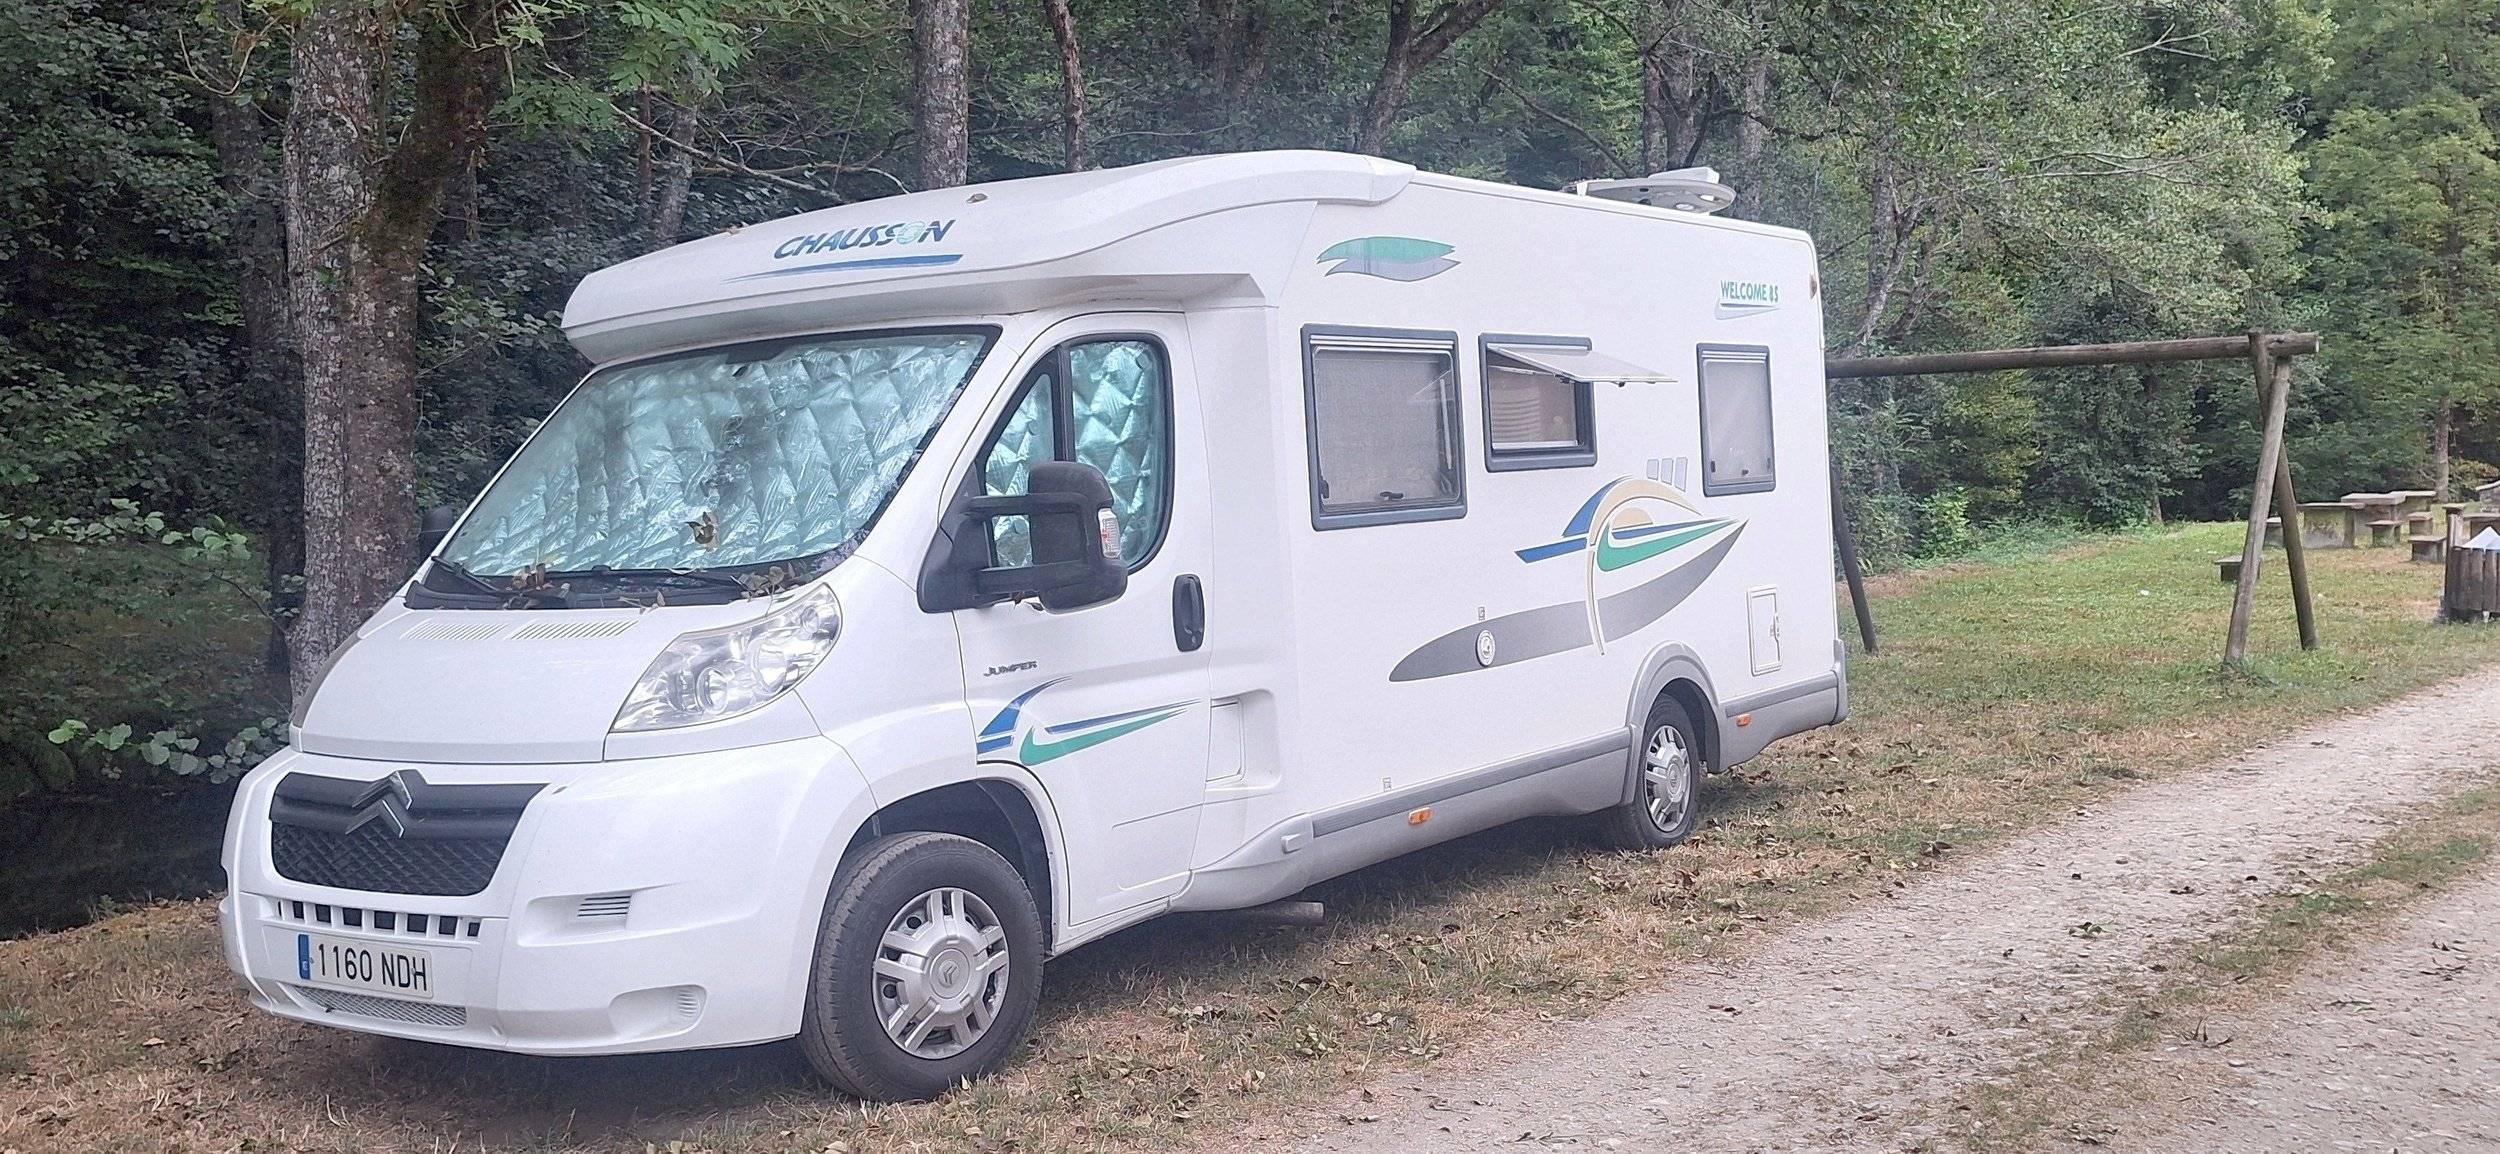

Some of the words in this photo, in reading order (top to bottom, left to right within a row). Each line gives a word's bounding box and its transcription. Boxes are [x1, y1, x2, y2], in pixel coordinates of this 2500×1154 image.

[774, 219, 956, 259] CHAUSSON
[1720, 280, 1767, 300] WELCOME
[983, 660, 1038, 677] JUMPER
[318, 943, 373, 982] 1160
[381, 952, 427, 991] NDH
